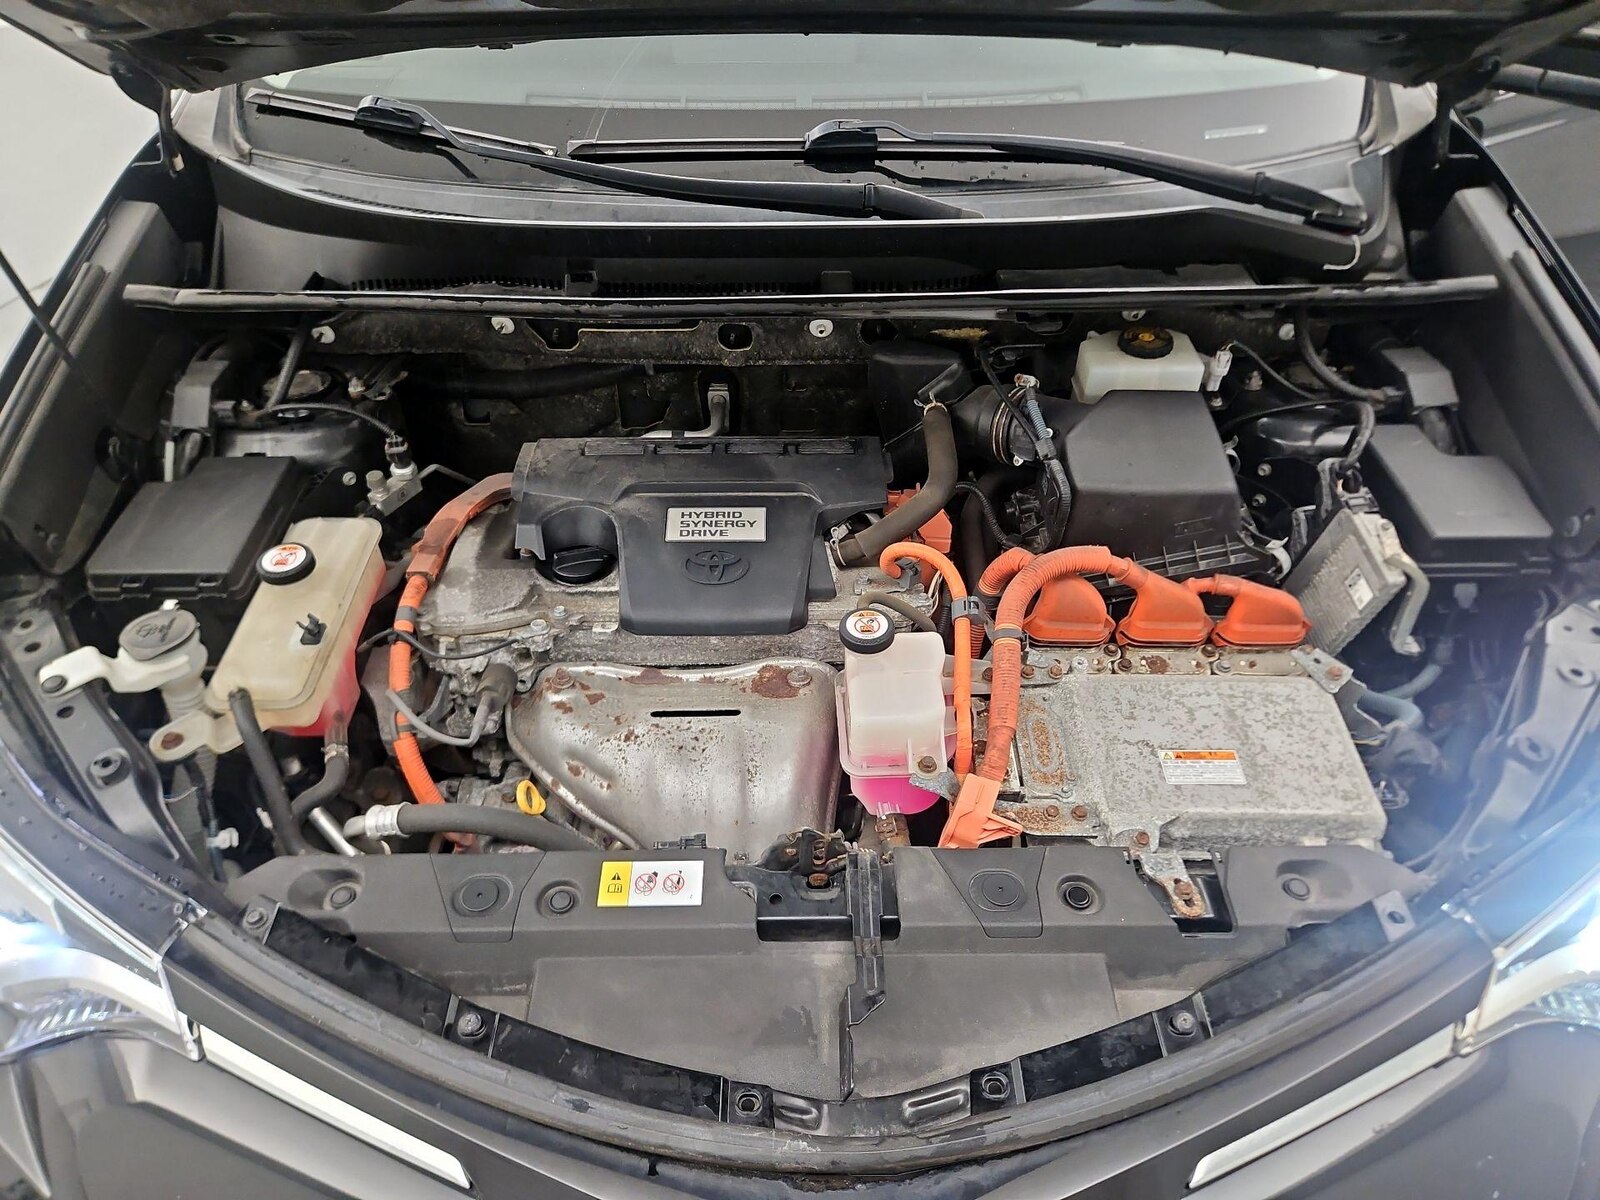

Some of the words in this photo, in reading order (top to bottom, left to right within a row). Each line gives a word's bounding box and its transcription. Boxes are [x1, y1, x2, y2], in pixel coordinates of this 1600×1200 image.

[681, 511, 743, 519] HYBRID
[680, 520, 757, 528] SYNERGY
[679, 529, 729, 537] DRIVE
